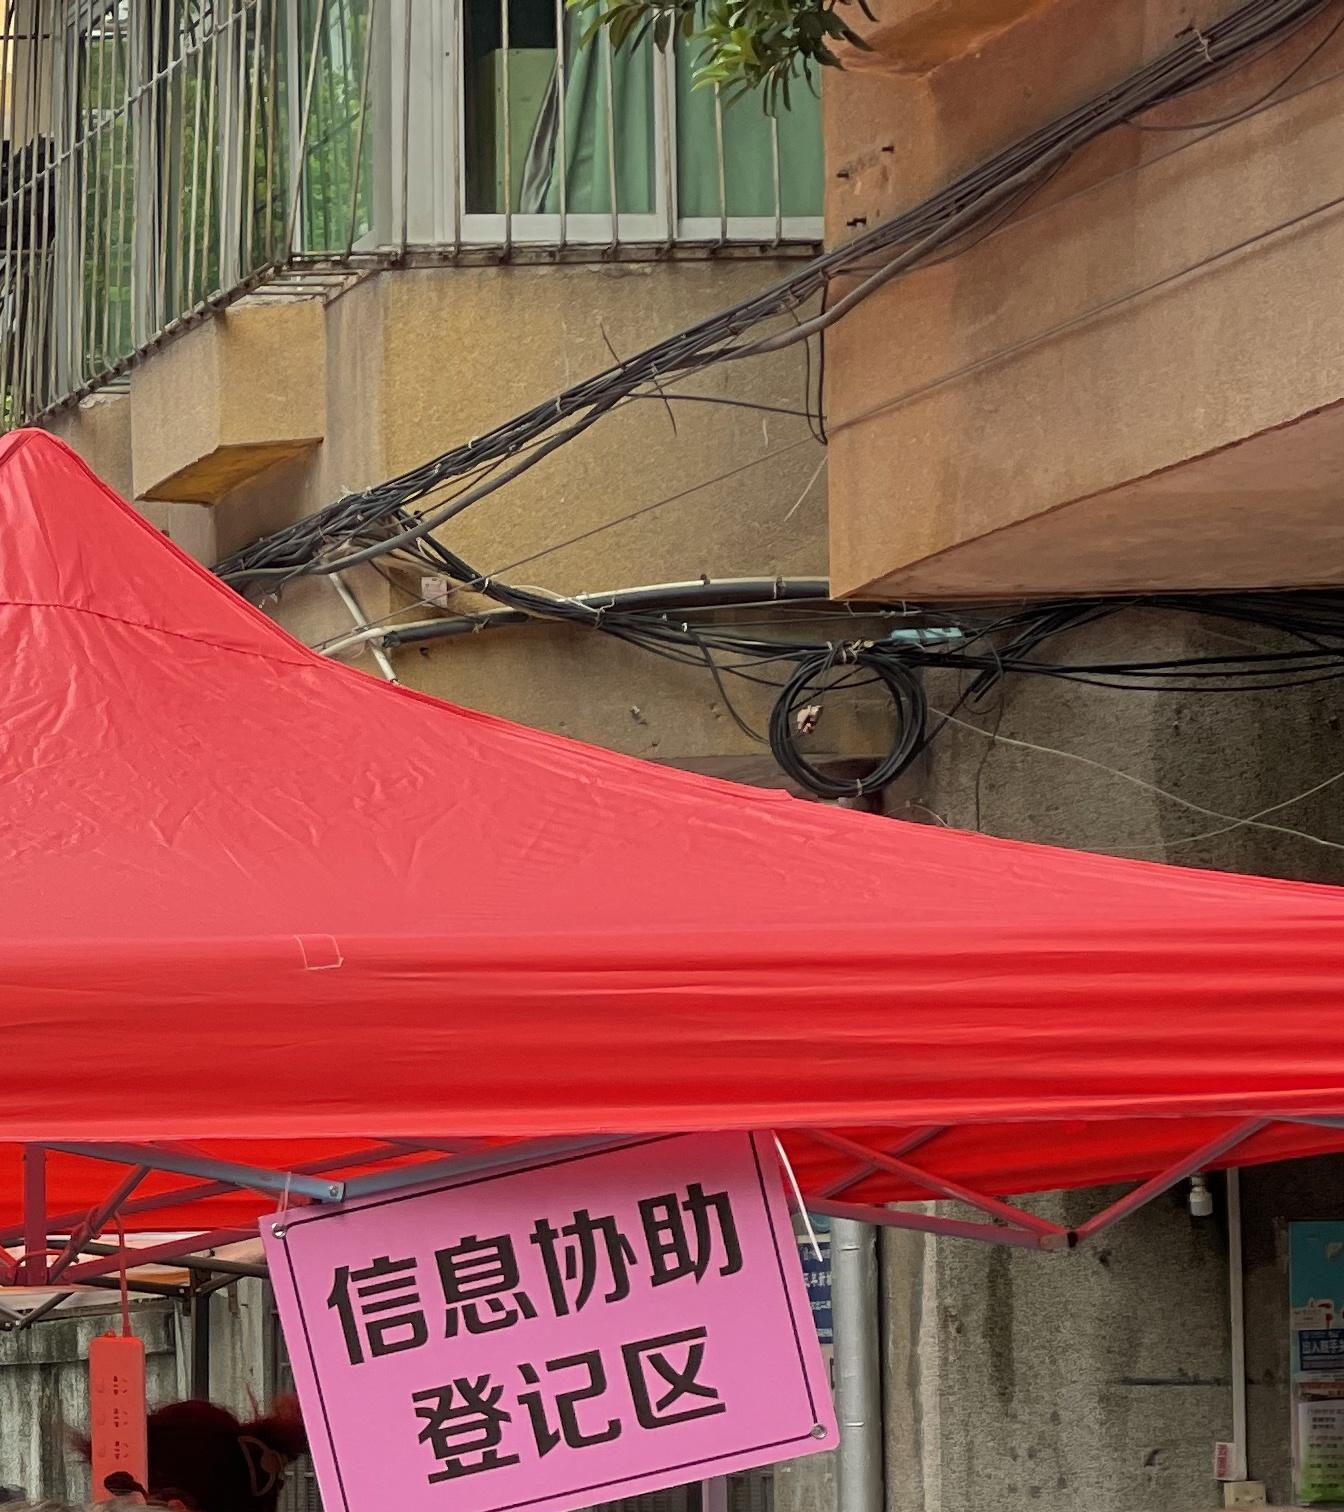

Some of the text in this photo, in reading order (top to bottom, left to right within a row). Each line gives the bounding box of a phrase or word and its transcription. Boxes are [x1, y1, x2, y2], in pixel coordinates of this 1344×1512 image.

[327, 1183, 743, 1366] 信息协助
[411, 1326, 726, 1484] 登记区
